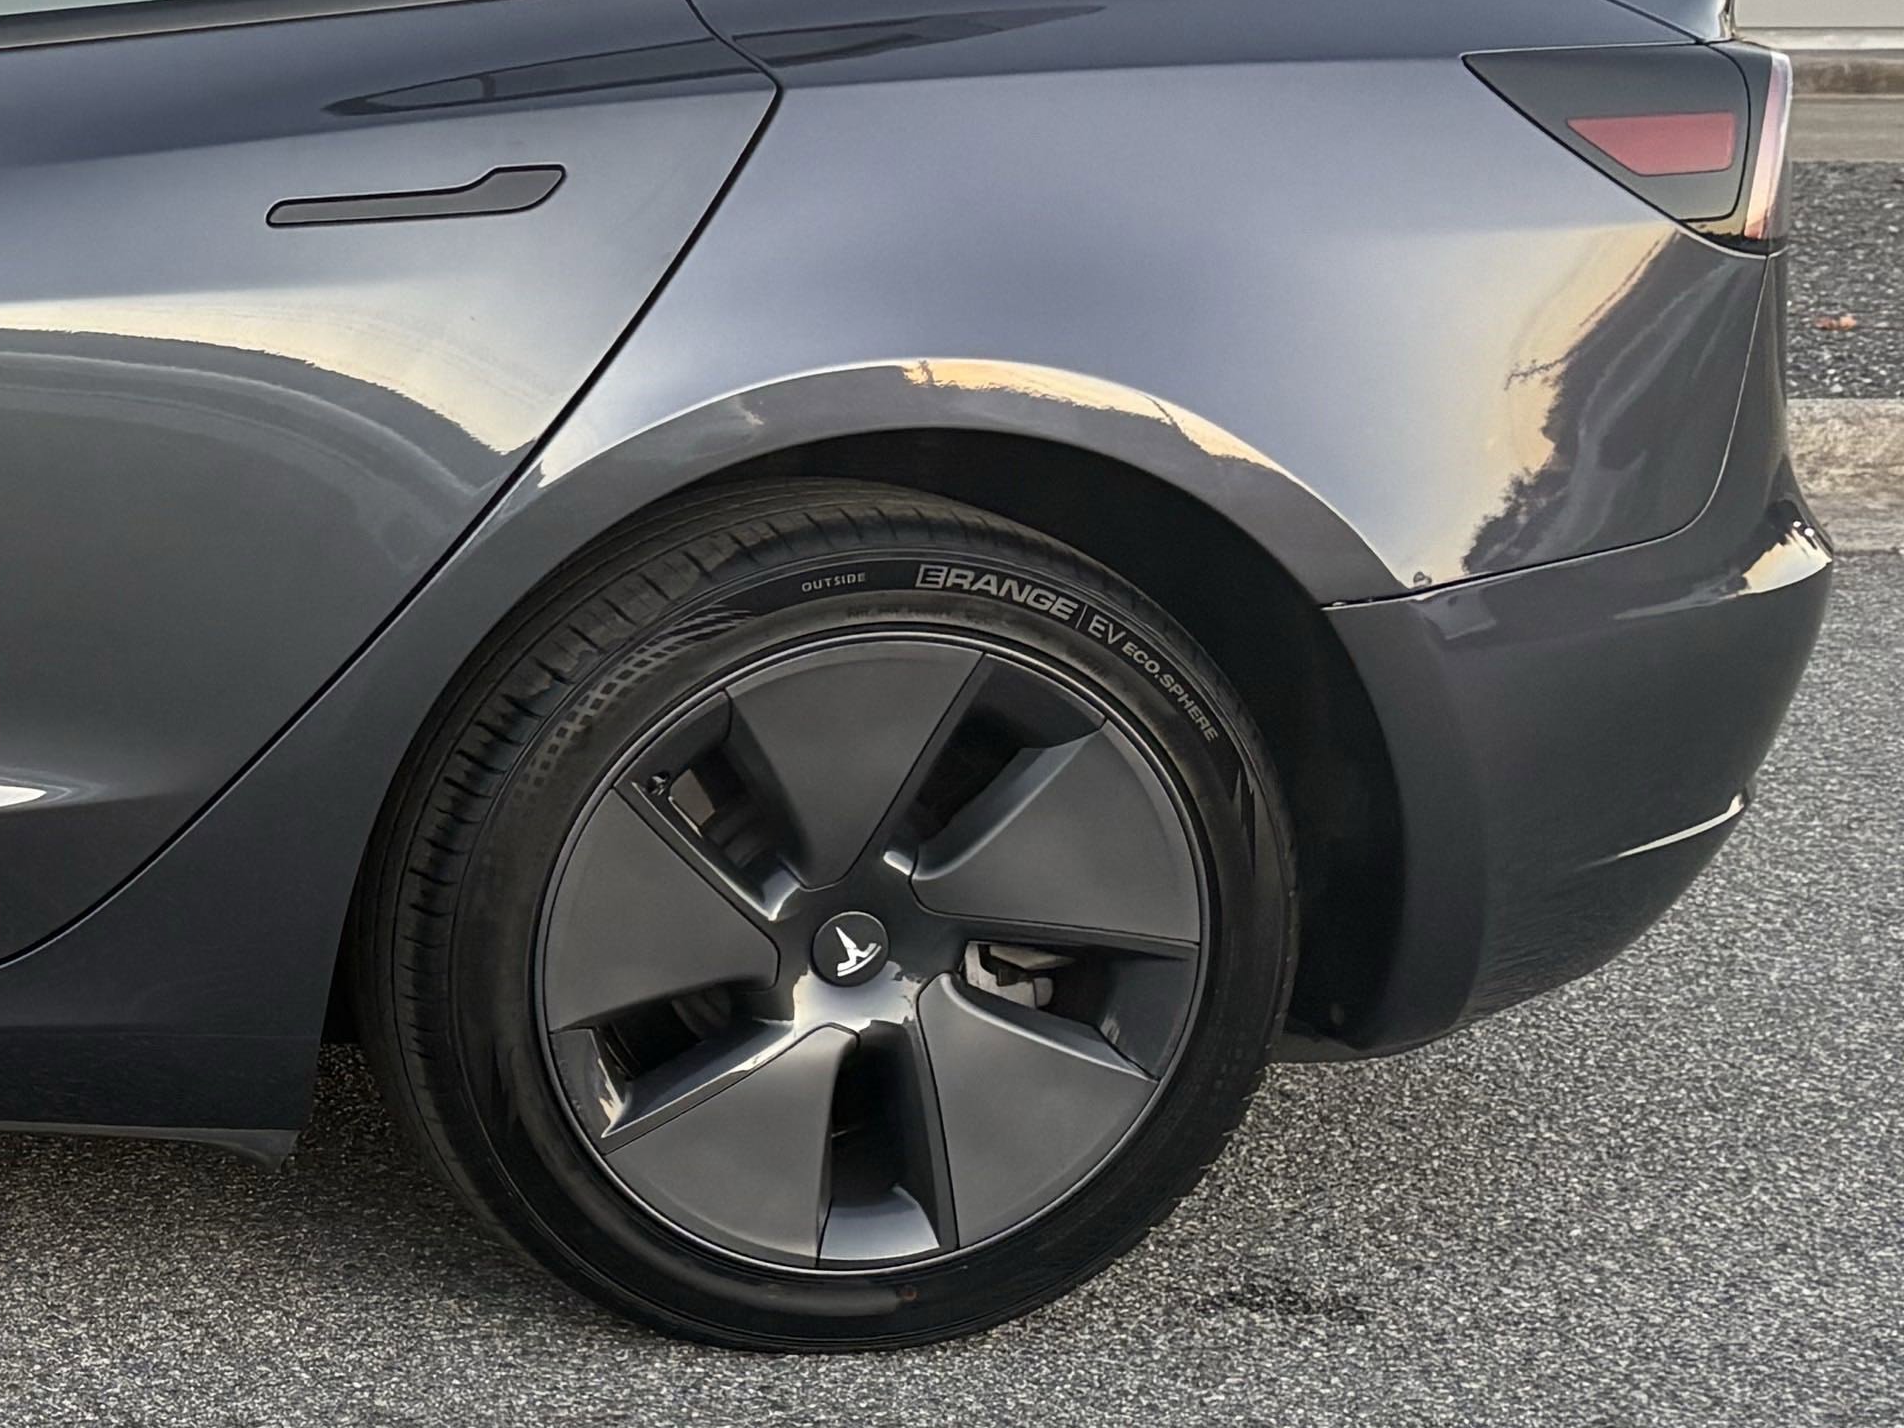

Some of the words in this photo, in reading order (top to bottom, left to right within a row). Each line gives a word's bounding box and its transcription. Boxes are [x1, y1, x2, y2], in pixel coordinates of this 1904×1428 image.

[801, 571, 866, 593] OUTSIDE
[915, 563, 1079, 621] ERANGE
[1087, 614, 1126, 645] EV
[1121, 641, 1219, 741] ECO.SPHERE
